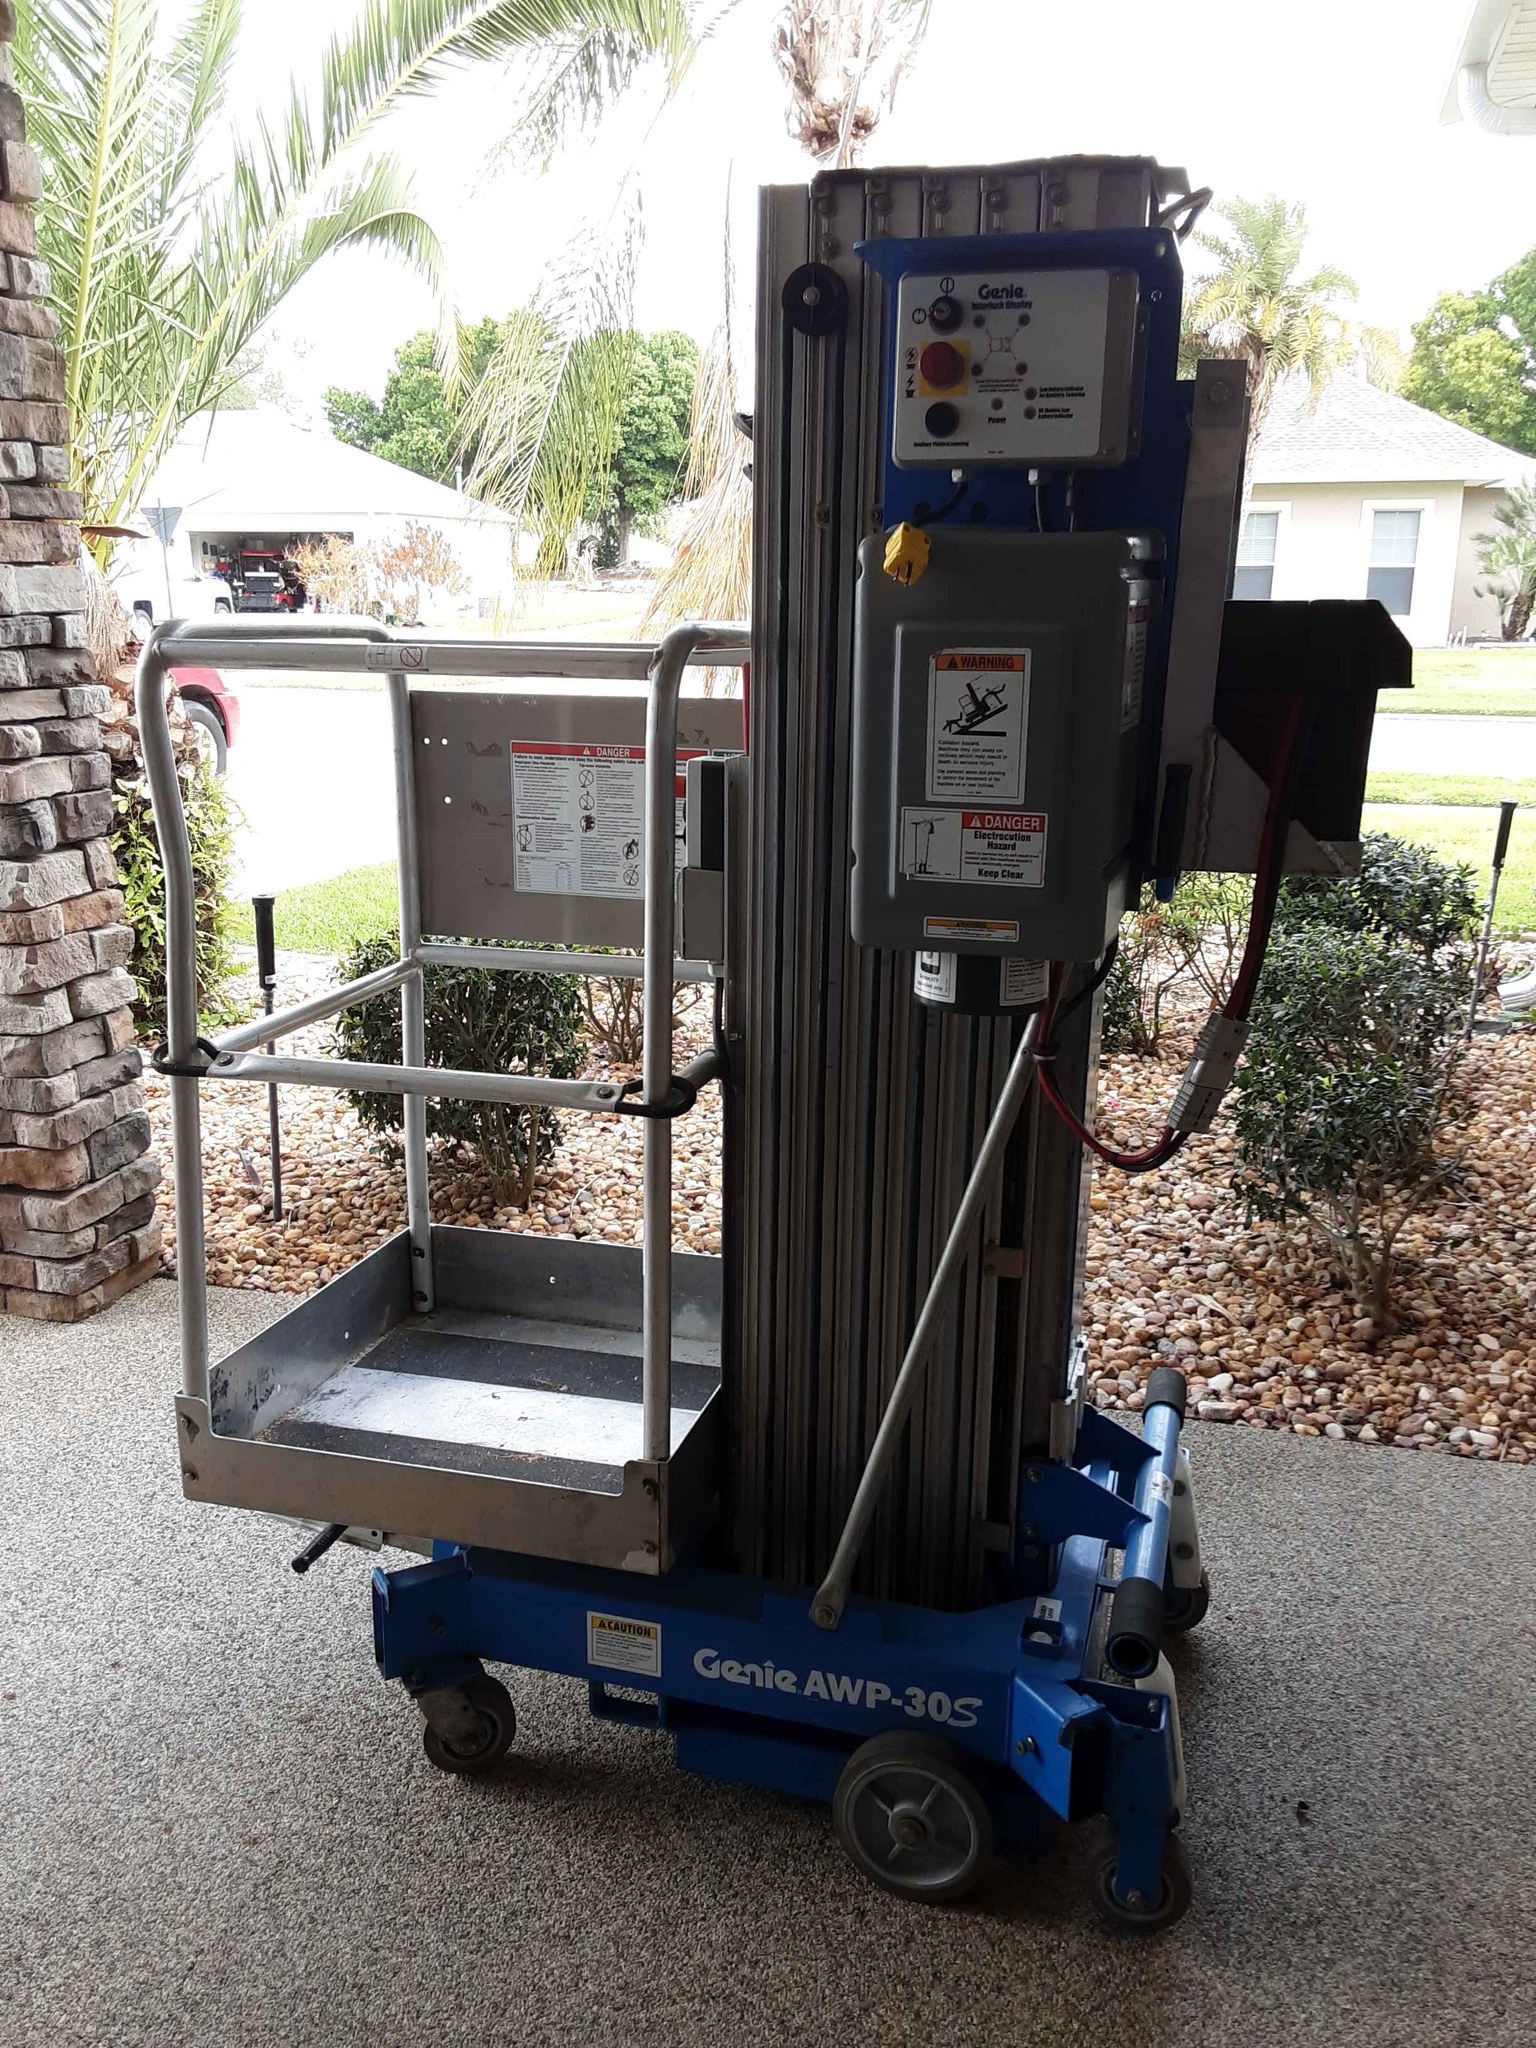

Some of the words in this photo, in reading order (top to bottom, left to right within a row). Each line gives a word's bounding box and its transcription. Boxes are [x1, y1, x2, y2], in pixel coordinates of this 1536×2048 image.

[978, 283, 1024, 300] Genie
[1005, 300, 1033, 310] Display
[988, 416, 1006, 424] Power
[961, 656, 1015, 669] WARNING
[596, 747, 630, 758] DANGER
[984, 815, 1040, 830] DANGER
[973, 830, 1031, 842] Electrocution
[987, 841, 1017, 851] Hazard
[977, 868, 999, 880] Keep
[1001, 868, 1025, 880] Clear
[607, 1621, 652, 1638] CAUTION
[692, 1647, 798, 1694] Genie
[802, 1669, 984, 1729] AWP-30S
